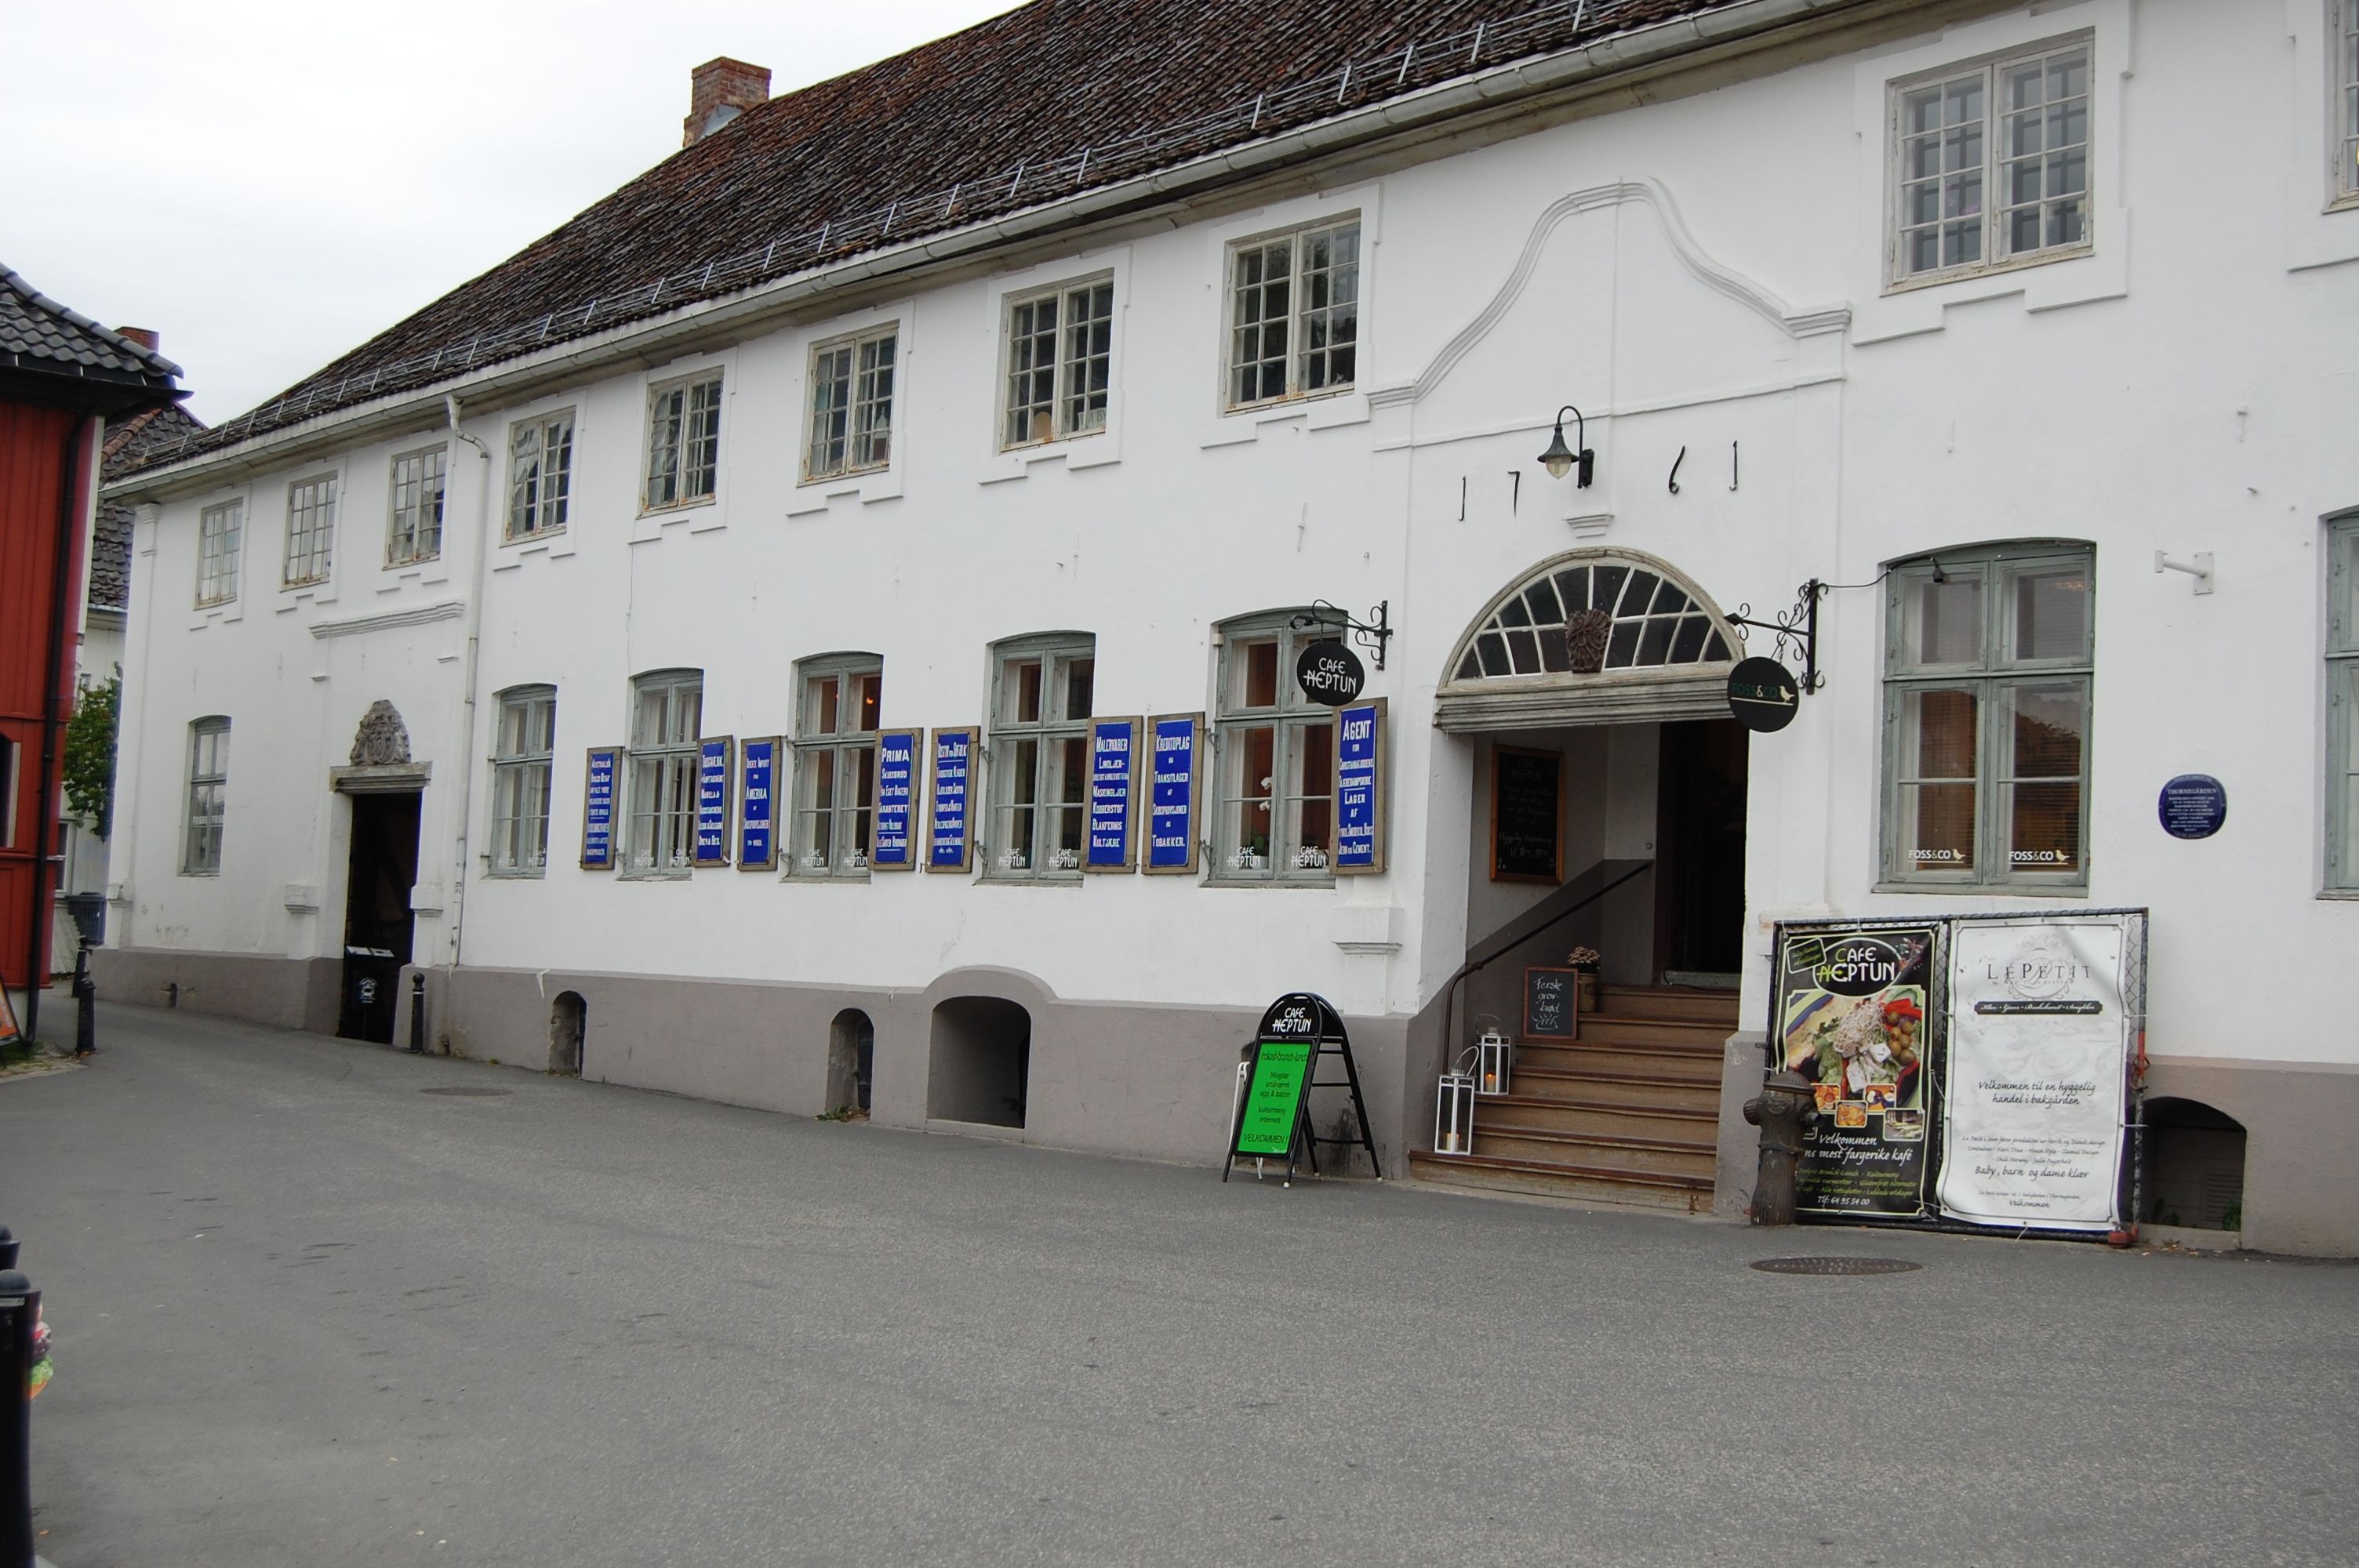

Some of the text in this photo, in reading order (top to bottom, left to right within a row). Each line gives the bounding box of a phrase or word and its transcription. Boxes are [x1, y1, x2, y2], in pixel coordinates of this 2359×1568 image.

[1318, 657, 1346, 675] CAFE
[1303, 672, 1357, 694] NEPTUN
[1732, 683, 1778, 699] FOSS&CO
[1343, 720, 1372, 741] AGENT
[881, 747, 910, 763] PRIMA
[1344, 792, 1365, 804] LAGER
[1350, 808, 1358, 818] AF
[1238, 846, 1255, 855] CAFE
[1300, 846, 1318, 855] CAFE
[1908, 849, 1951, 860] FOSS&CO
[2008, 851, 2054, 861] FOSS&CO
[998, 856, 1026, 867] NEPTUN
[1048, 856, 1078, 868] NEPTUN
[1227, 855, 1261, 867] NEPTUN
[1291, 855, 1326, 867] NEPTUN
[1835, 946, 1877, 963] CAFE
[1816, 962, 1895, 983] NEPTUN
[1285, 1007, 1305, 1018] CAFE
[1272, 1018, 1312, 1033] NEPTUN
[1979, 1080, 2030, 1091] Velkommen
[2032, 1081, 2042, 1091] til
[2059, 1080, 2096, 1097] hyggelig
[1992, 1093, 2023, 1104] handel
[2031, 1094, 2080, 1109] bakgården
[1819, 1133, 1877, 1151] Velkommen
[1819, 1149, 1842, 1159] mest
[1842, 1148, 1890, 1166] fargerike
[1891, 1149, 1914, 1167] kafé
[2002, 1167, 2024, 1176] barn
[2029, 1171, 2038, 1181] og
[2041, 1167, 2065, 1178] dame
[2068, 1168, 2089, 1178] klær
[2009, 1200, 2050, 1208] Velkommen
